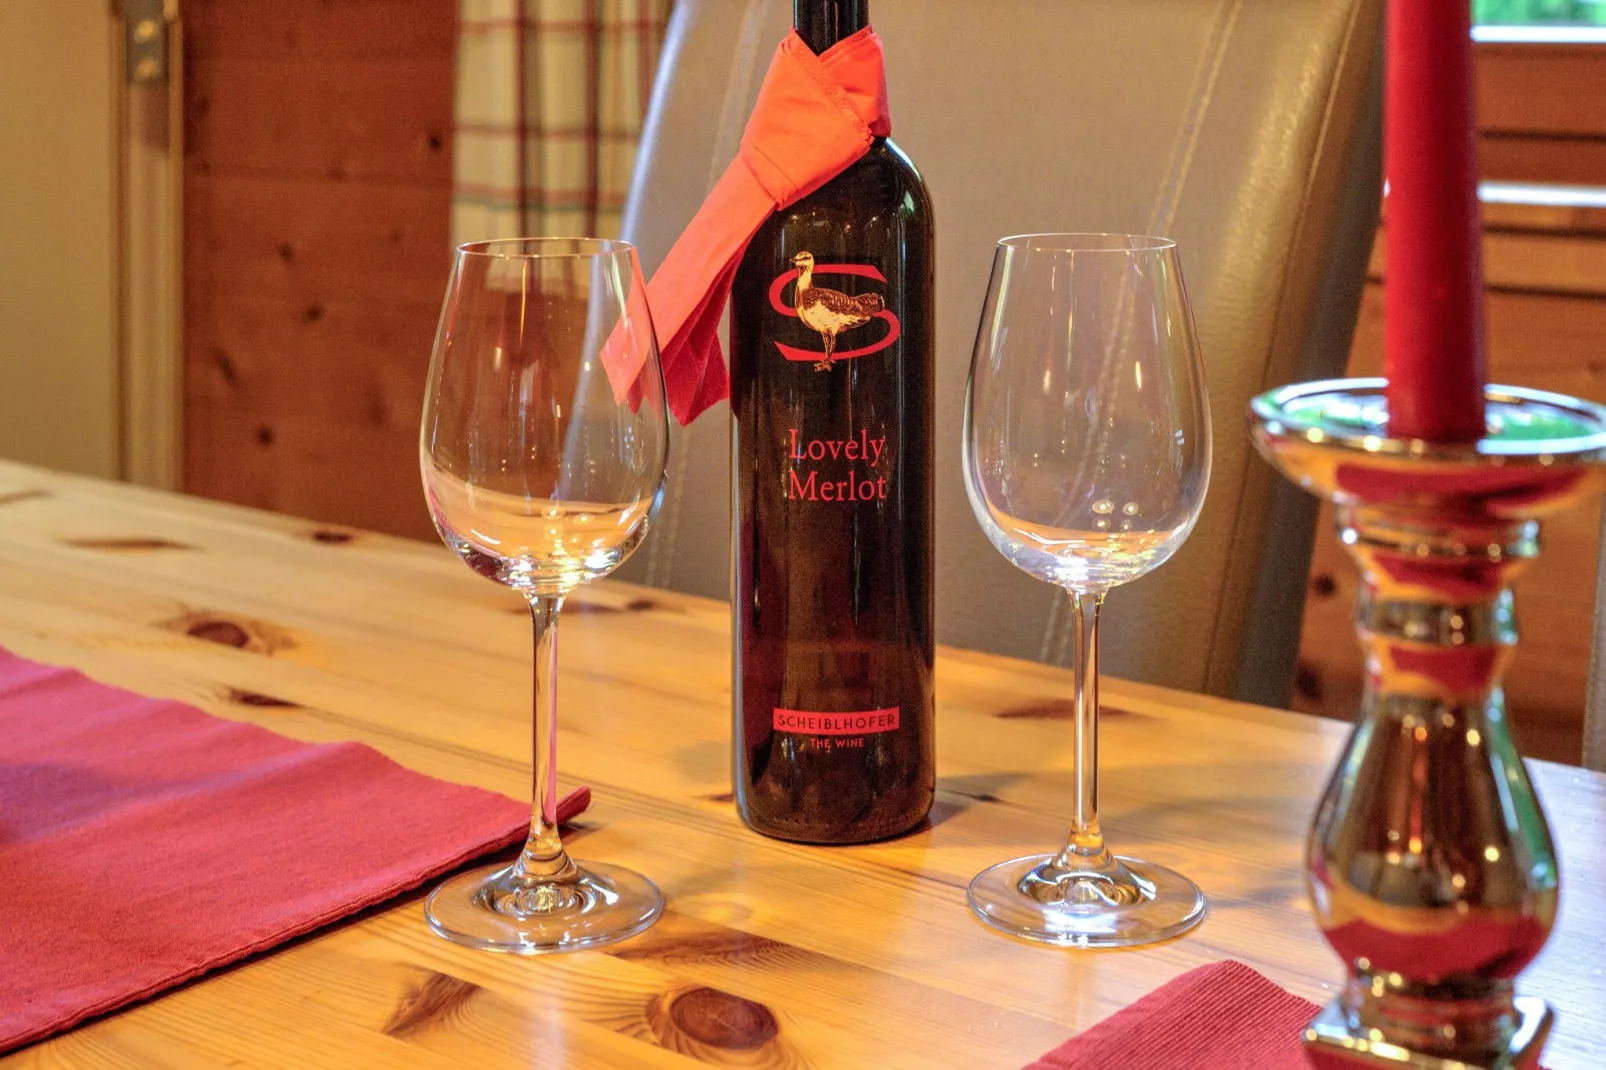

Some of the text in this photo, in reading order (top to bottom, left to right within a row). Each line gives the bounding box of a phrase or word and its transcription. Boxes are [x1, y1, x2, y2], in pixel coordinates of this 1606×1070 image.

[789, 428, 885, 467] Lovely
[788, 469, 887, 501] Merlot
[778, 714, 895, 730] SCHEIBLHOFER
[810, 738, 864, 748] THE WINE
